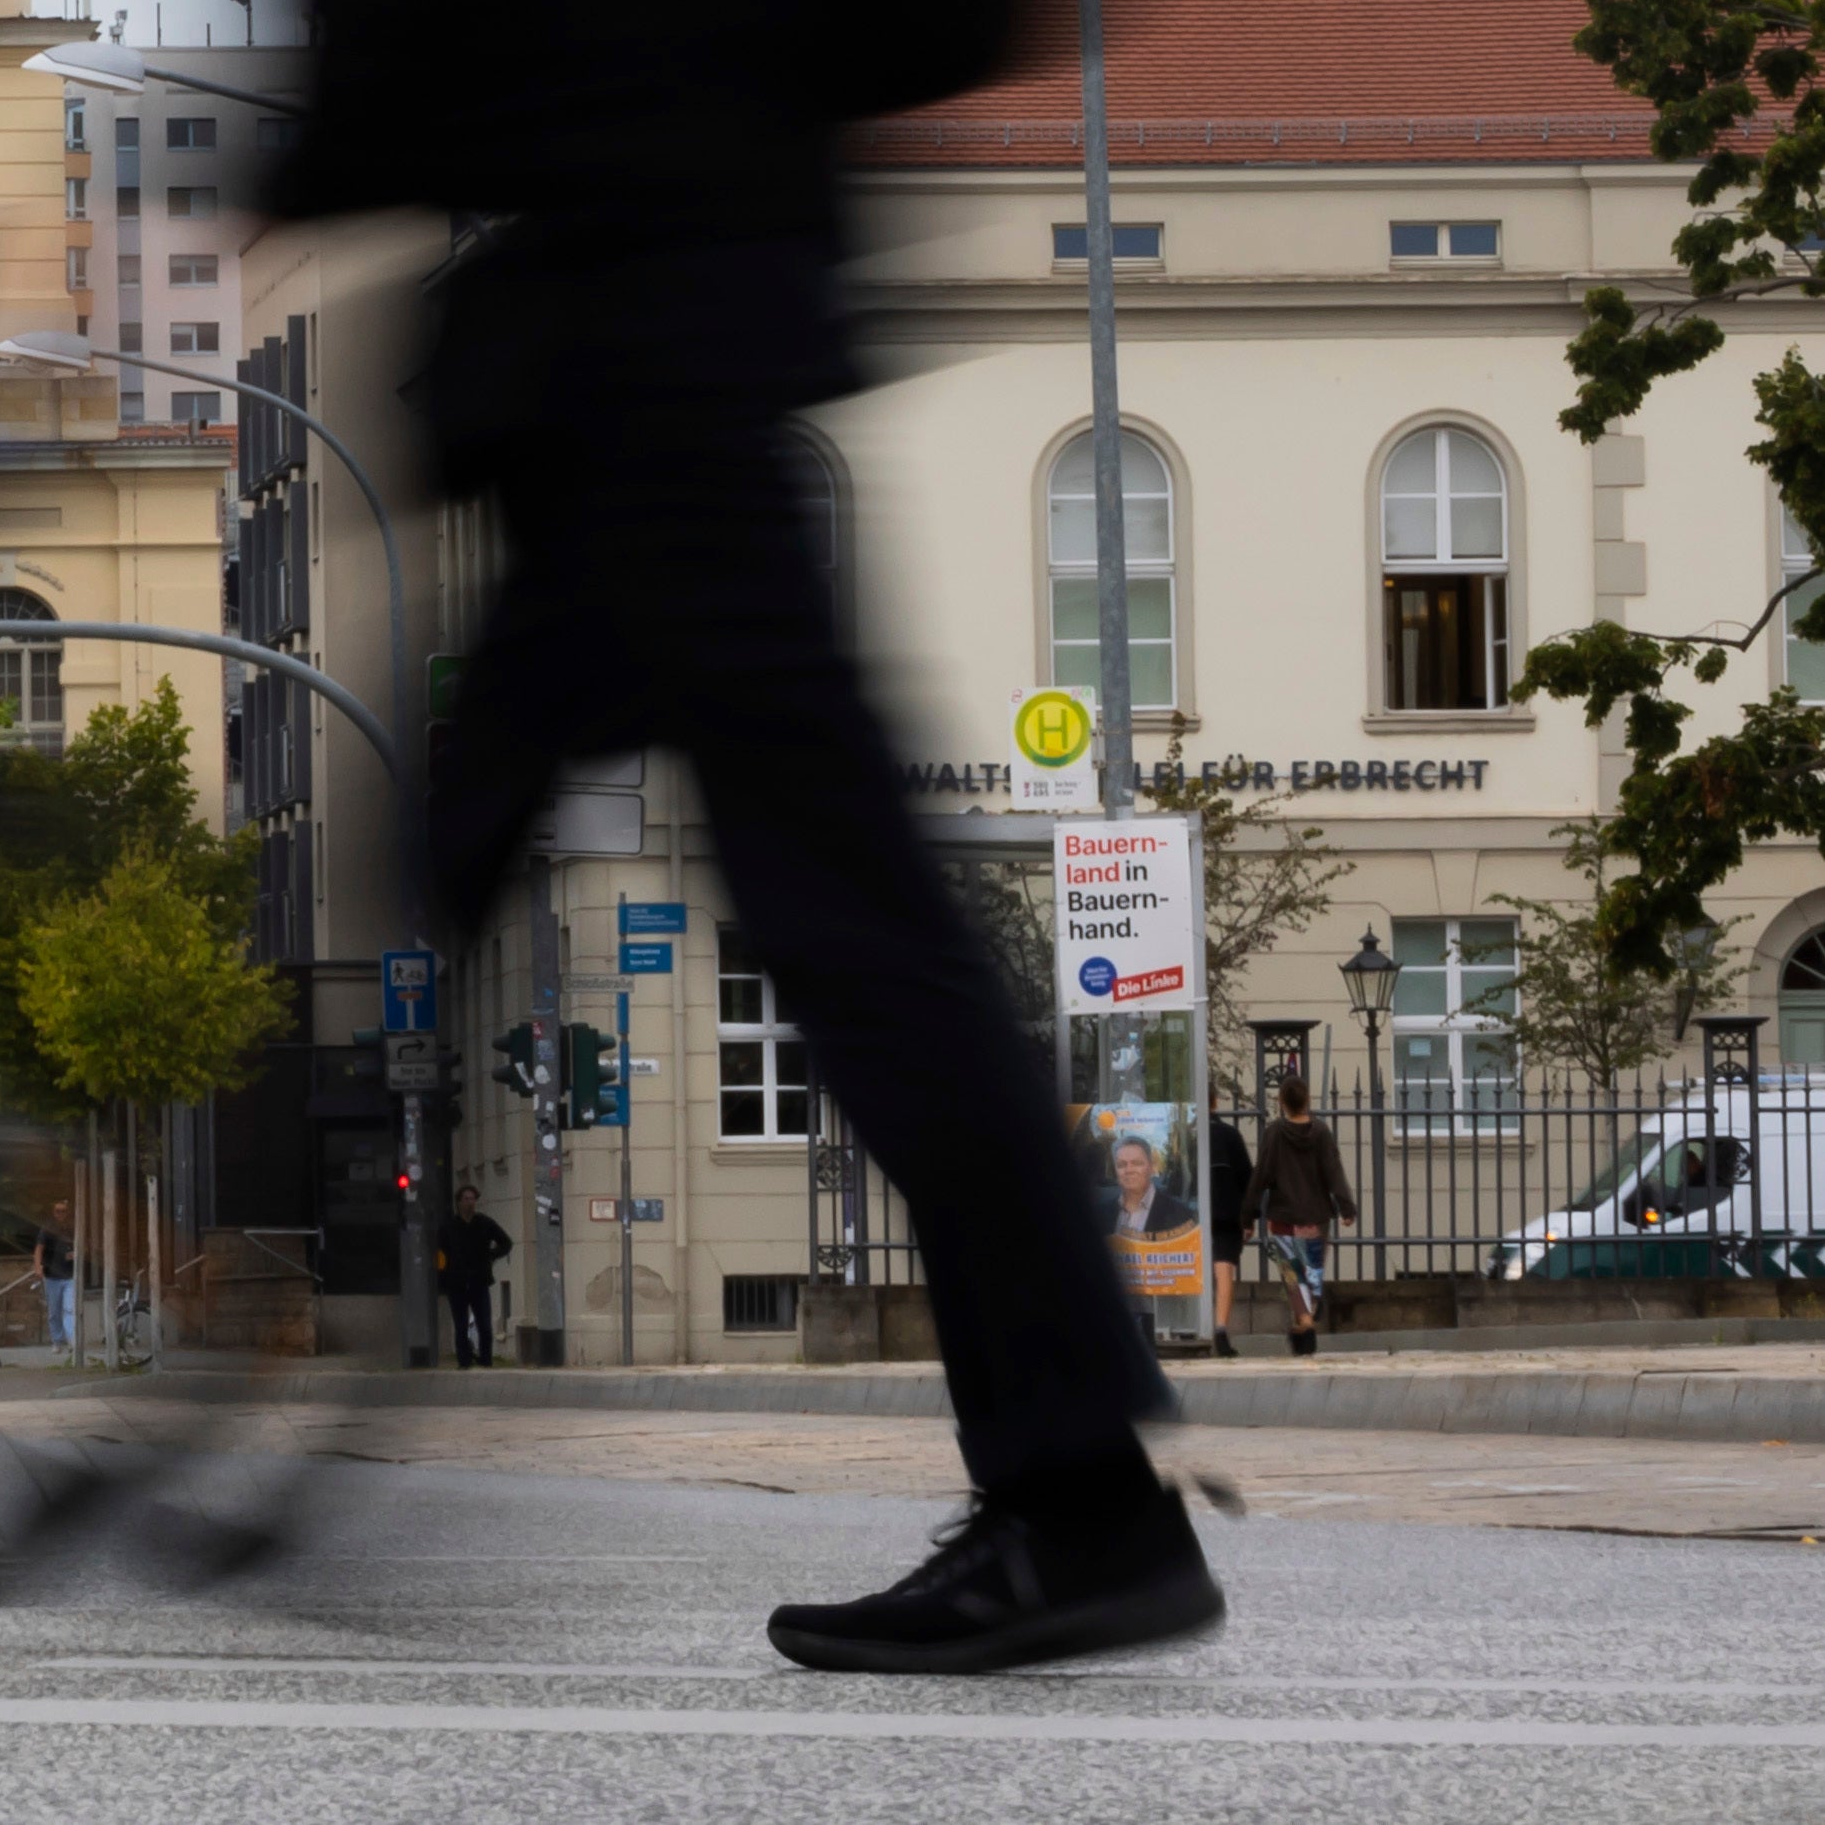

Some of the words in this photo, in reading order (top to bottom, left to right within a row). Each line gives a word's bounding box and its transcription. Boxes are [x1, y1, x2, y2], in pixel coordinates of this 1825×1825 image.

[1037, 708, 1069, 750] H
[1202, 754, 1275, 791] FÜR
[1291, 760, 1490, 791] ERBRECHT
[1065, 835, 1168, 857] Bauern-
[1066, 861, 1121, 885] land
[1125, 860, 1148, 882] in
[1068, 891, 1169, 912] Bauern-
[1069, 917, 1139, 940] hand.
[1117, 982, 1141, 998] Die
[1143, 973, 1179, 992] Linke
